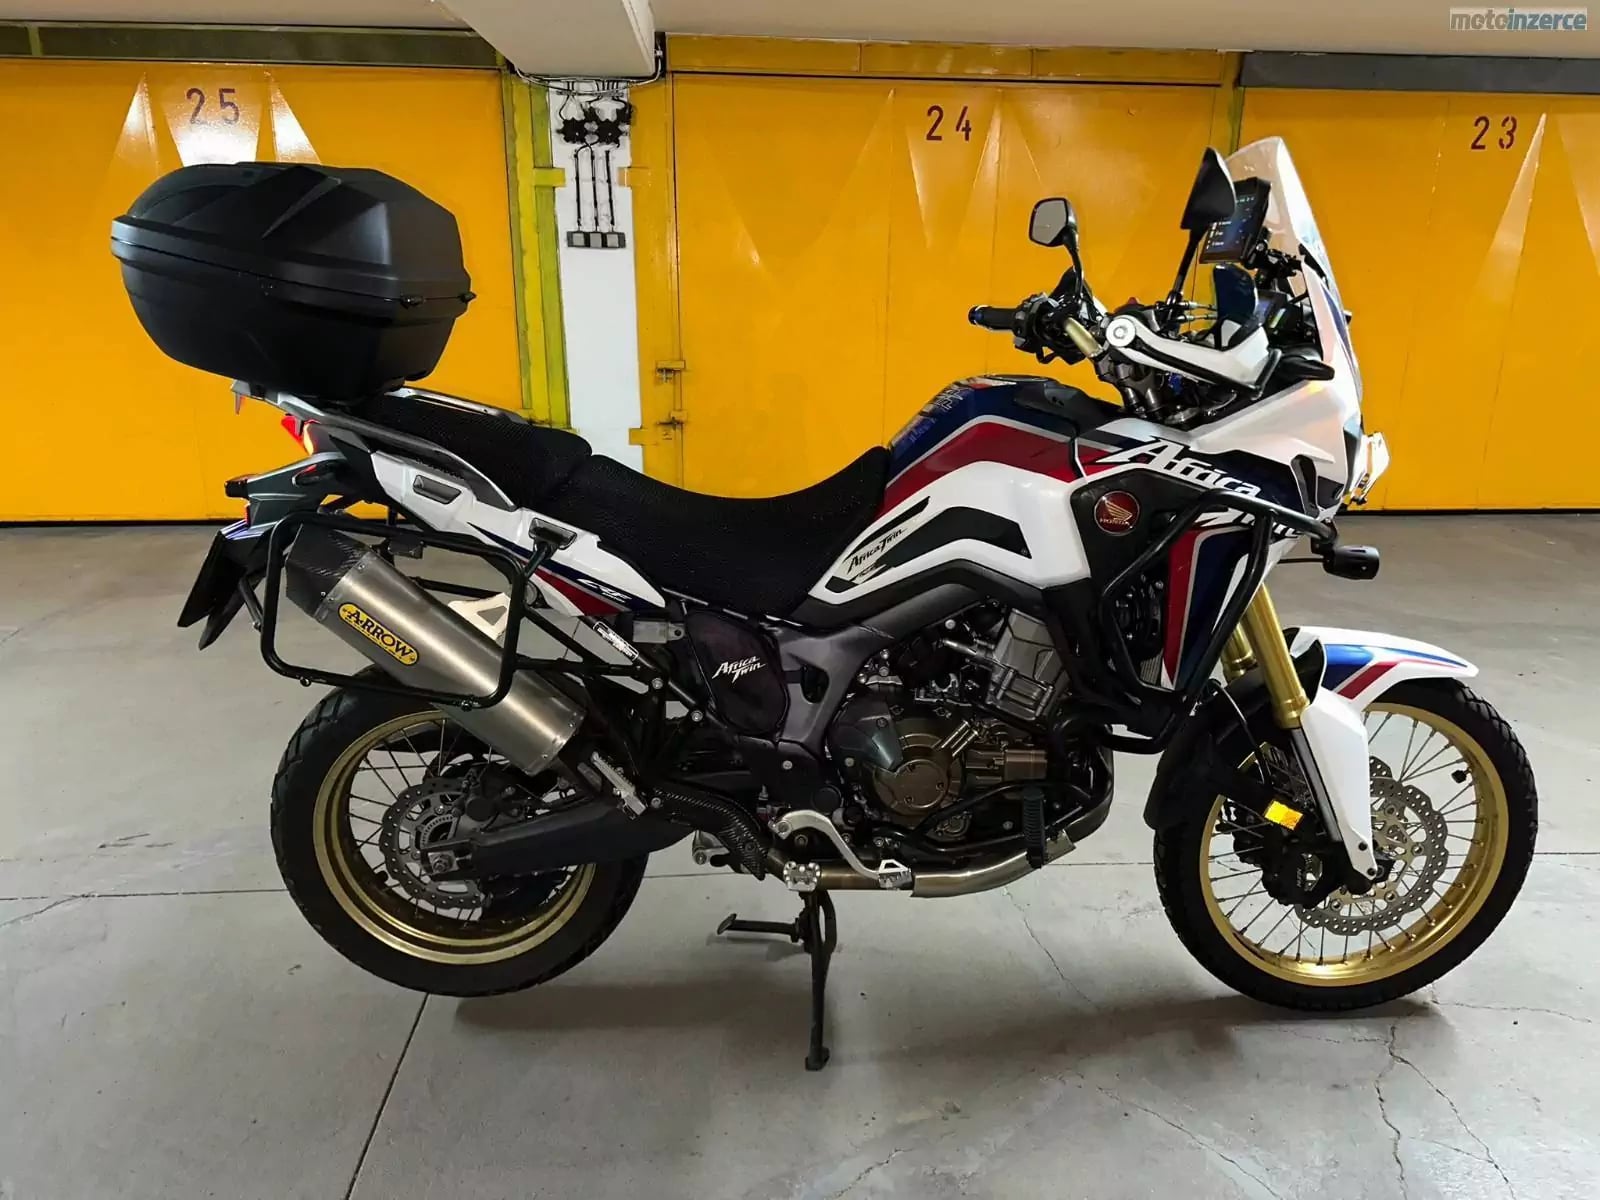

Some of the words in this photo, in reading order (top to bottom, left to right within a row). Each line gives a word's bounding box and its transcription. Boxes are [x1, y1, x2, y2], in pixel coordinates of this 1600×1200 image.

[186, 87, 240, 125] 25
[926, 104, 972, 142] 24
[1470, 115, 1518, 150] 23
[1095, 438, 1262, 499] Africa
[846, 545, 881, 576] Africa
[879, 527, 908, 553] Twin
[344, 609, 414, 657] ARROW
[711, 655, 760, 680] Africa
[731, 662, 767, 684] Twin
